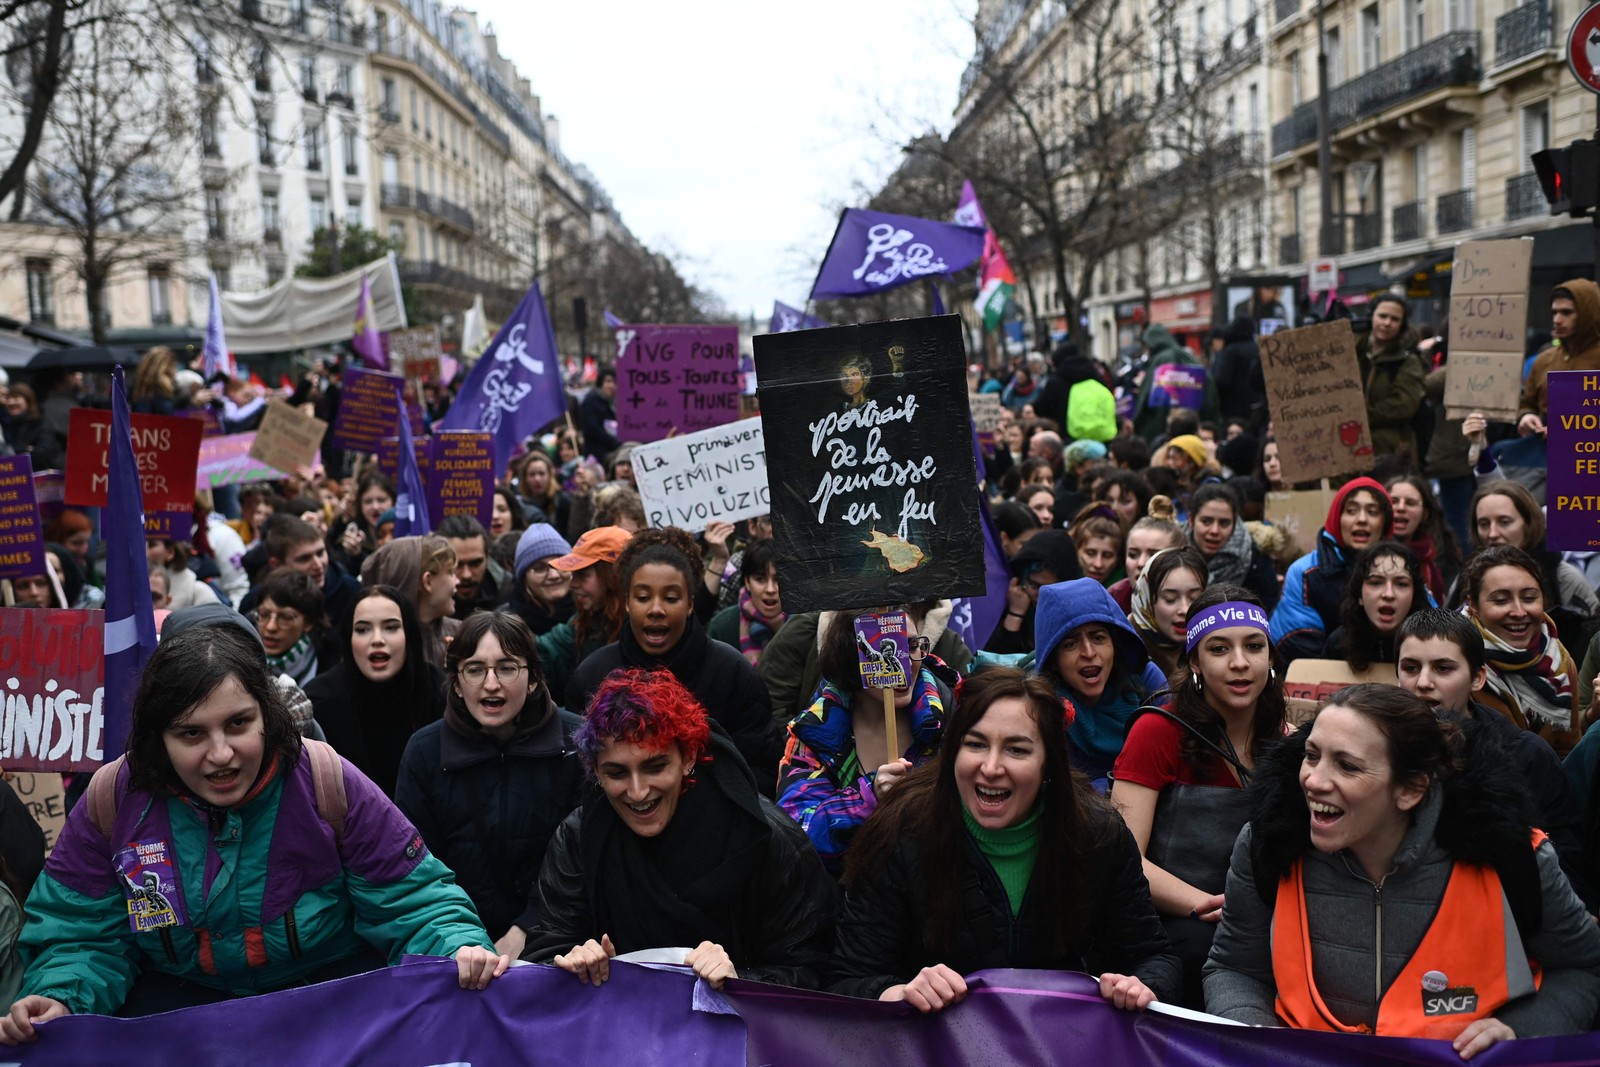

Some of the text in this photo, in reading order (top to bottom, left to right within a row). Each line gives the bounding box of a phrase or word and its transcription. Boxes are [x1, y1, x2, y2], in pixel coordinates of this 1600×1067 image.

[691, 342, 735, 359] POUR
[1583, 375, 1600, 391] H
[678, 389, 739, 410] THUNE
[808, 394, 920, 458] portrait
[1560, 414, 1600, 430] VIO
[90, 423, 171, 451] TANS
[687, 428, 762, 464] primaver
[826, 426, 892, 470] de la
[102, 450, 158, 470] LES
[435, 458, 491, 470] SOLIDARITÉ
[640, 454, 669, 473] La
[1575, 459, 1600, 474] FE
[663, 450, 767, 496] FEMINIST
[808, 455, 937, 525] jeunesse
[650, 485, 770, 530] RIVOLUZIO
[842, 487, 937, 542] en feu
[15, 517, 34, 527] PAS
[17, 532, 36, 543] DES
[877, 615, 904, 626] RÉFORME
[880, 624, 903, 634] SEXISTE
[1186, 607, 1271, 644] Femme Vie Liber
[24, 794, 64, 821] TRE
[1425, 995, 1475, 1013] SNCF
